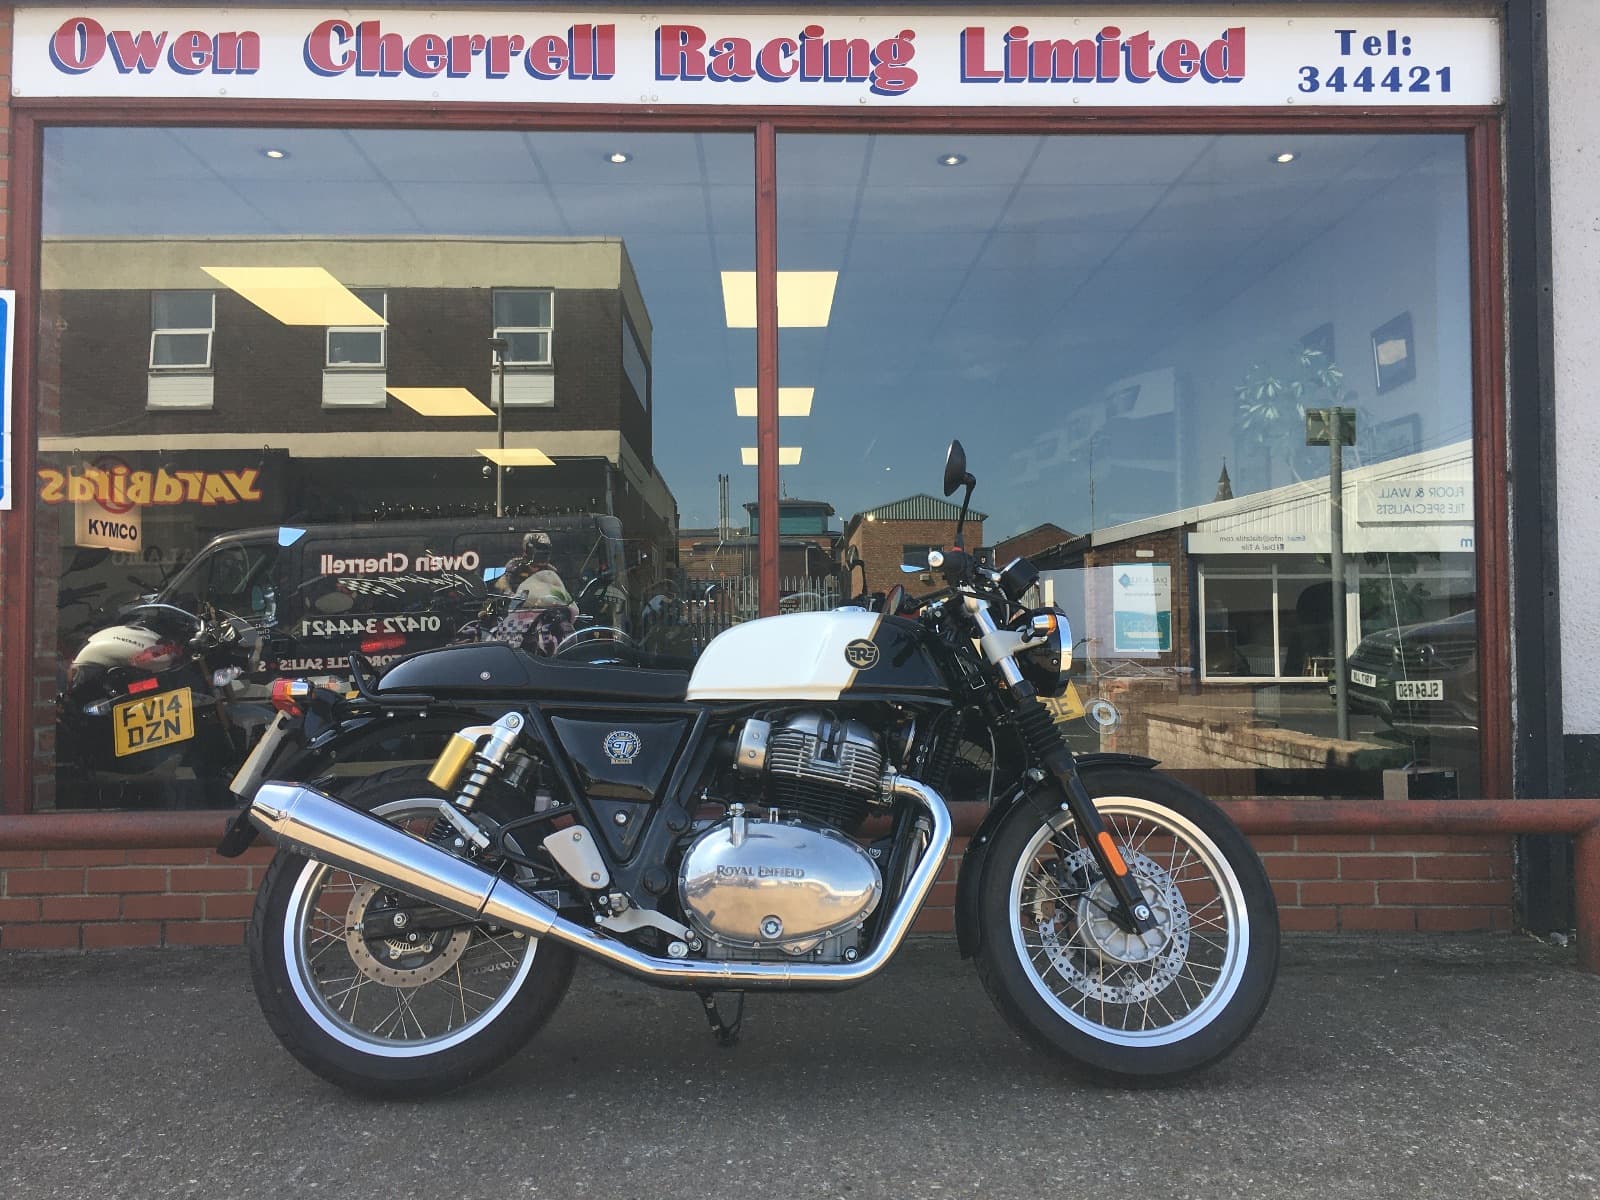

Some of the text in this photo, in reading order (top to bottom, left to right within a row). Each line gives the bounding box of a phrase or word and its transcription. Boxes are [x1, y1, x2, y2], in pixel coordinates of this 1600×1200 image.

[49, 17, 1246, 96] Owen Cherrell Racing Limited
[1334, 29, 1412, 57] Tel:
[1297, 65, 1451, 93] 344421
[88, 518, 138, 541] KYMCO
[122, 695, 183, 727] FV14
[128, 716, 181, 748] DZN
[716, 864, 805, 879] ROYAL ENFIELD
